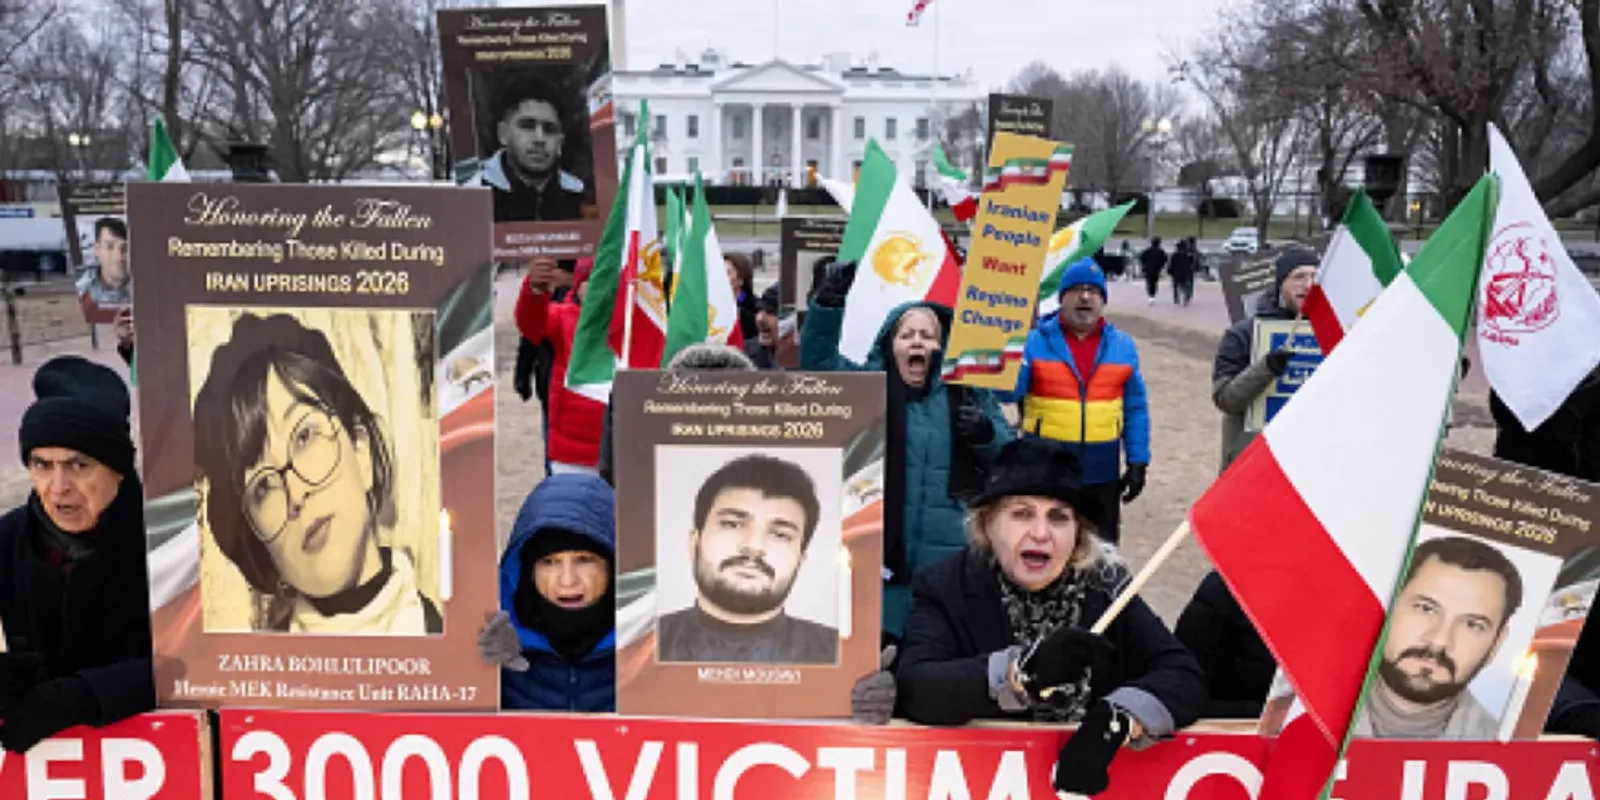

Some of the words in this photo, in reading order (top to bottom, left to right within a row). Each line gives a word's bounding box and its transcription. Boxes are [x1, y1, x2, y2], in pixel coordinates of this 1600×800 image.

[184, 192, 306, 238] Honoring
[312, 204, 345, 228] the
[350, 198, 434, 229] Fallen
[986, 199, 1050, 224] Iranian
[981, 223, 1041, 247] People
[168, 236, 283, 264] Remembering
[286, 239, 337, 260] Those
[340, 241, 387, 260] Killed
[391, 243, 444, 266] During
[982, 256, 1028, 276] Want
[205, 272, 249, 292] IRAN
[253, 272, 352, 293] UPRISINGS
[356, 270, 410, 294] 2026
[966, 284, 1028, 307] Regime
[961, 309, 1025, 333] Change
[655, 372, 750, 400] Honoring
[752, 377, 780, 395] the
[643, 399, 731, 417] Remembering
[774, 401, 808, 416] Killed
[810, 402, 853, 419] During
[783, 421, 824, 439] 2026
[1515, 520, 1558, 544] 2026
[217, 654, 285, 673] ZAHRA
[228, 680, 273, 698] MEK
[275, 682, 355, 700] Resistance
[357, 684, 394, 701] Unit
[396, 683, 478, 701] RAHA-17
[231, 730, 532, 800] 3000
